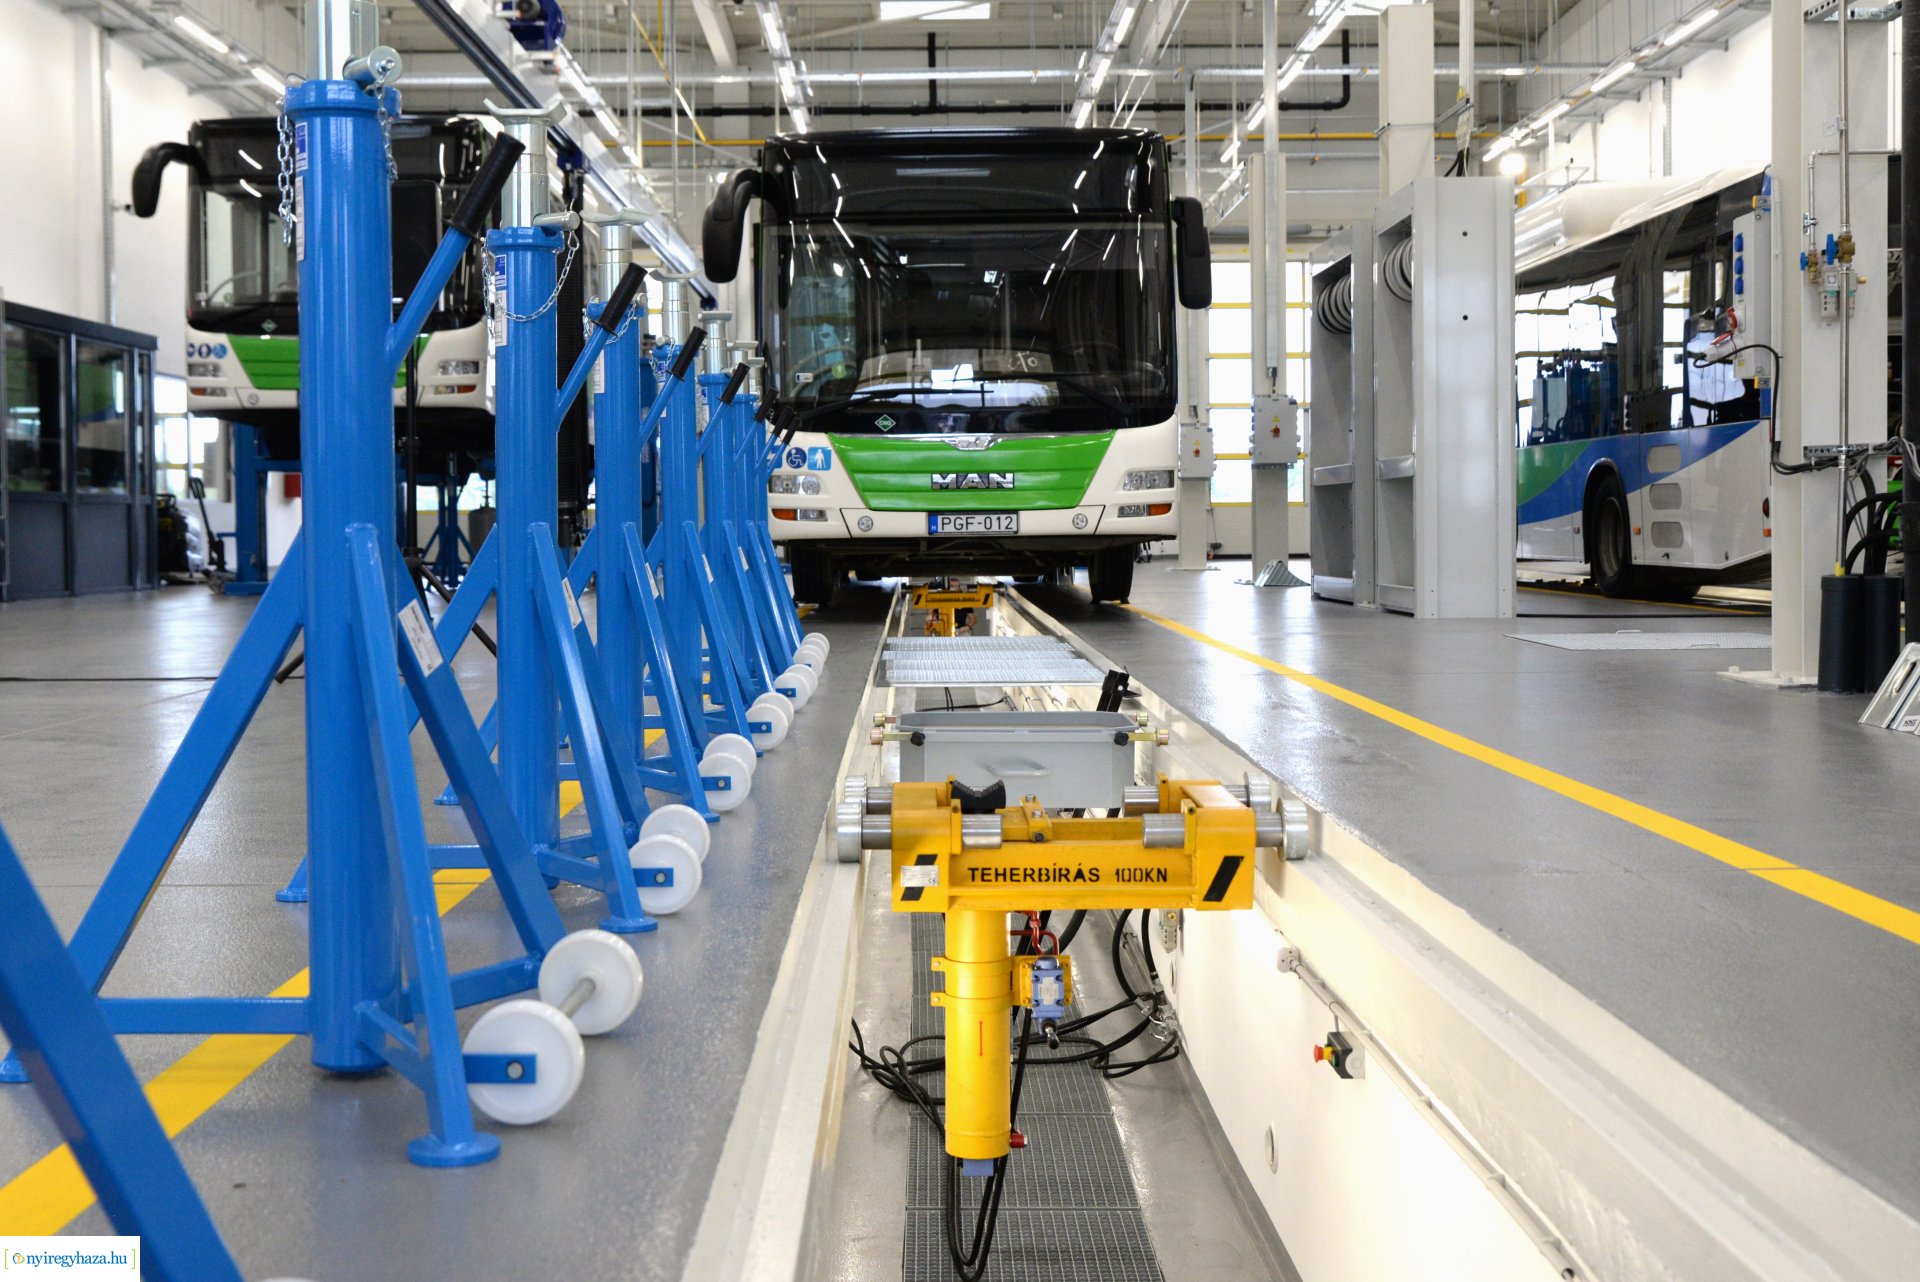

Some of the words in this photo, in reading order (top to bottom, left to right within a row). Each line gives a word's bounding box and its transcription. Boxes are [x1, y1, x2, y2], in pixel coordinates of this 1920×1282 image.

[932, 473, 1014, 489] MAN
[941, 516, 1013, 531] PGF-012
[967, 863, 1101, 883] TEHERBÍRÁS
[1115, 867, 1168, 883] 100KN
